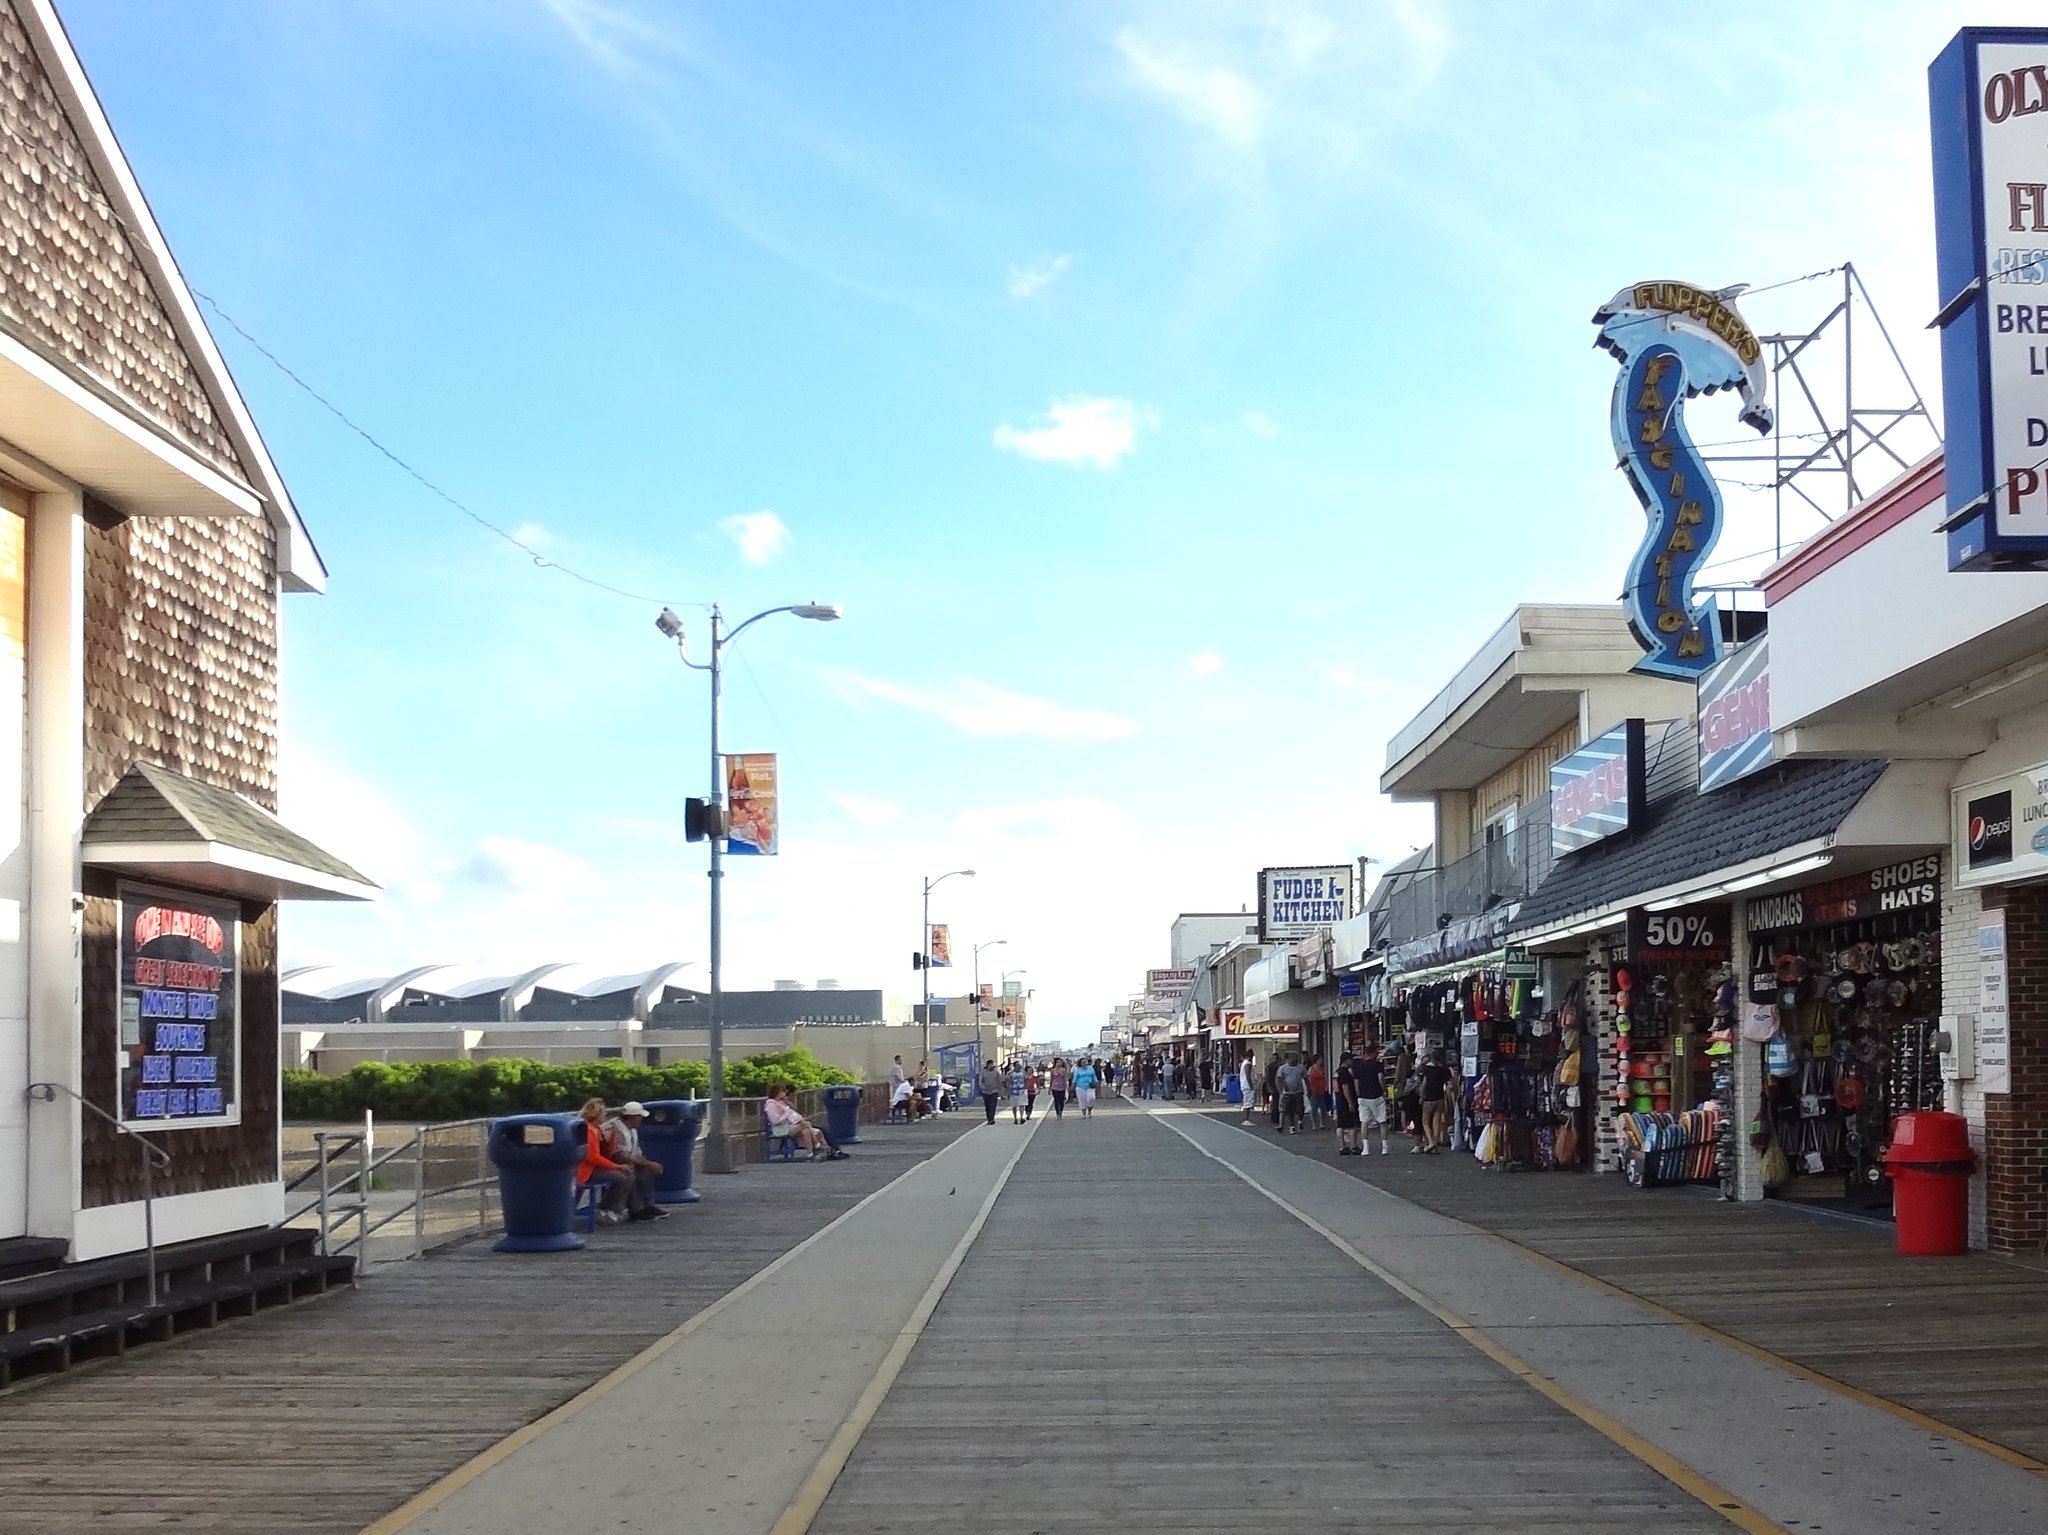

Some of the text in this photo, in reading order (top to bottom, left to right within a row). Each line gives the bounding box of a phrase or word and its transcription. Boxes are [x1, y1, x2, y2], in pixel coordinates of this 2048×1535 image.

[2030, 346, 2048, 375] L
[1636, 356, 1704, 658] FASCINATION
[1986, 816, 2011, 840] pepsi
[1870, 856, 1938, 890] SHOES
[1273, 878, 1323, 900] FUDGE
[1880, 884, 1935, 911] HATS
[1273, 901, 1344, 922] KITCHEN
[1747, 892, 1803, 932] HANDBAGS
[1646, 915, 1714, 946] 50%
